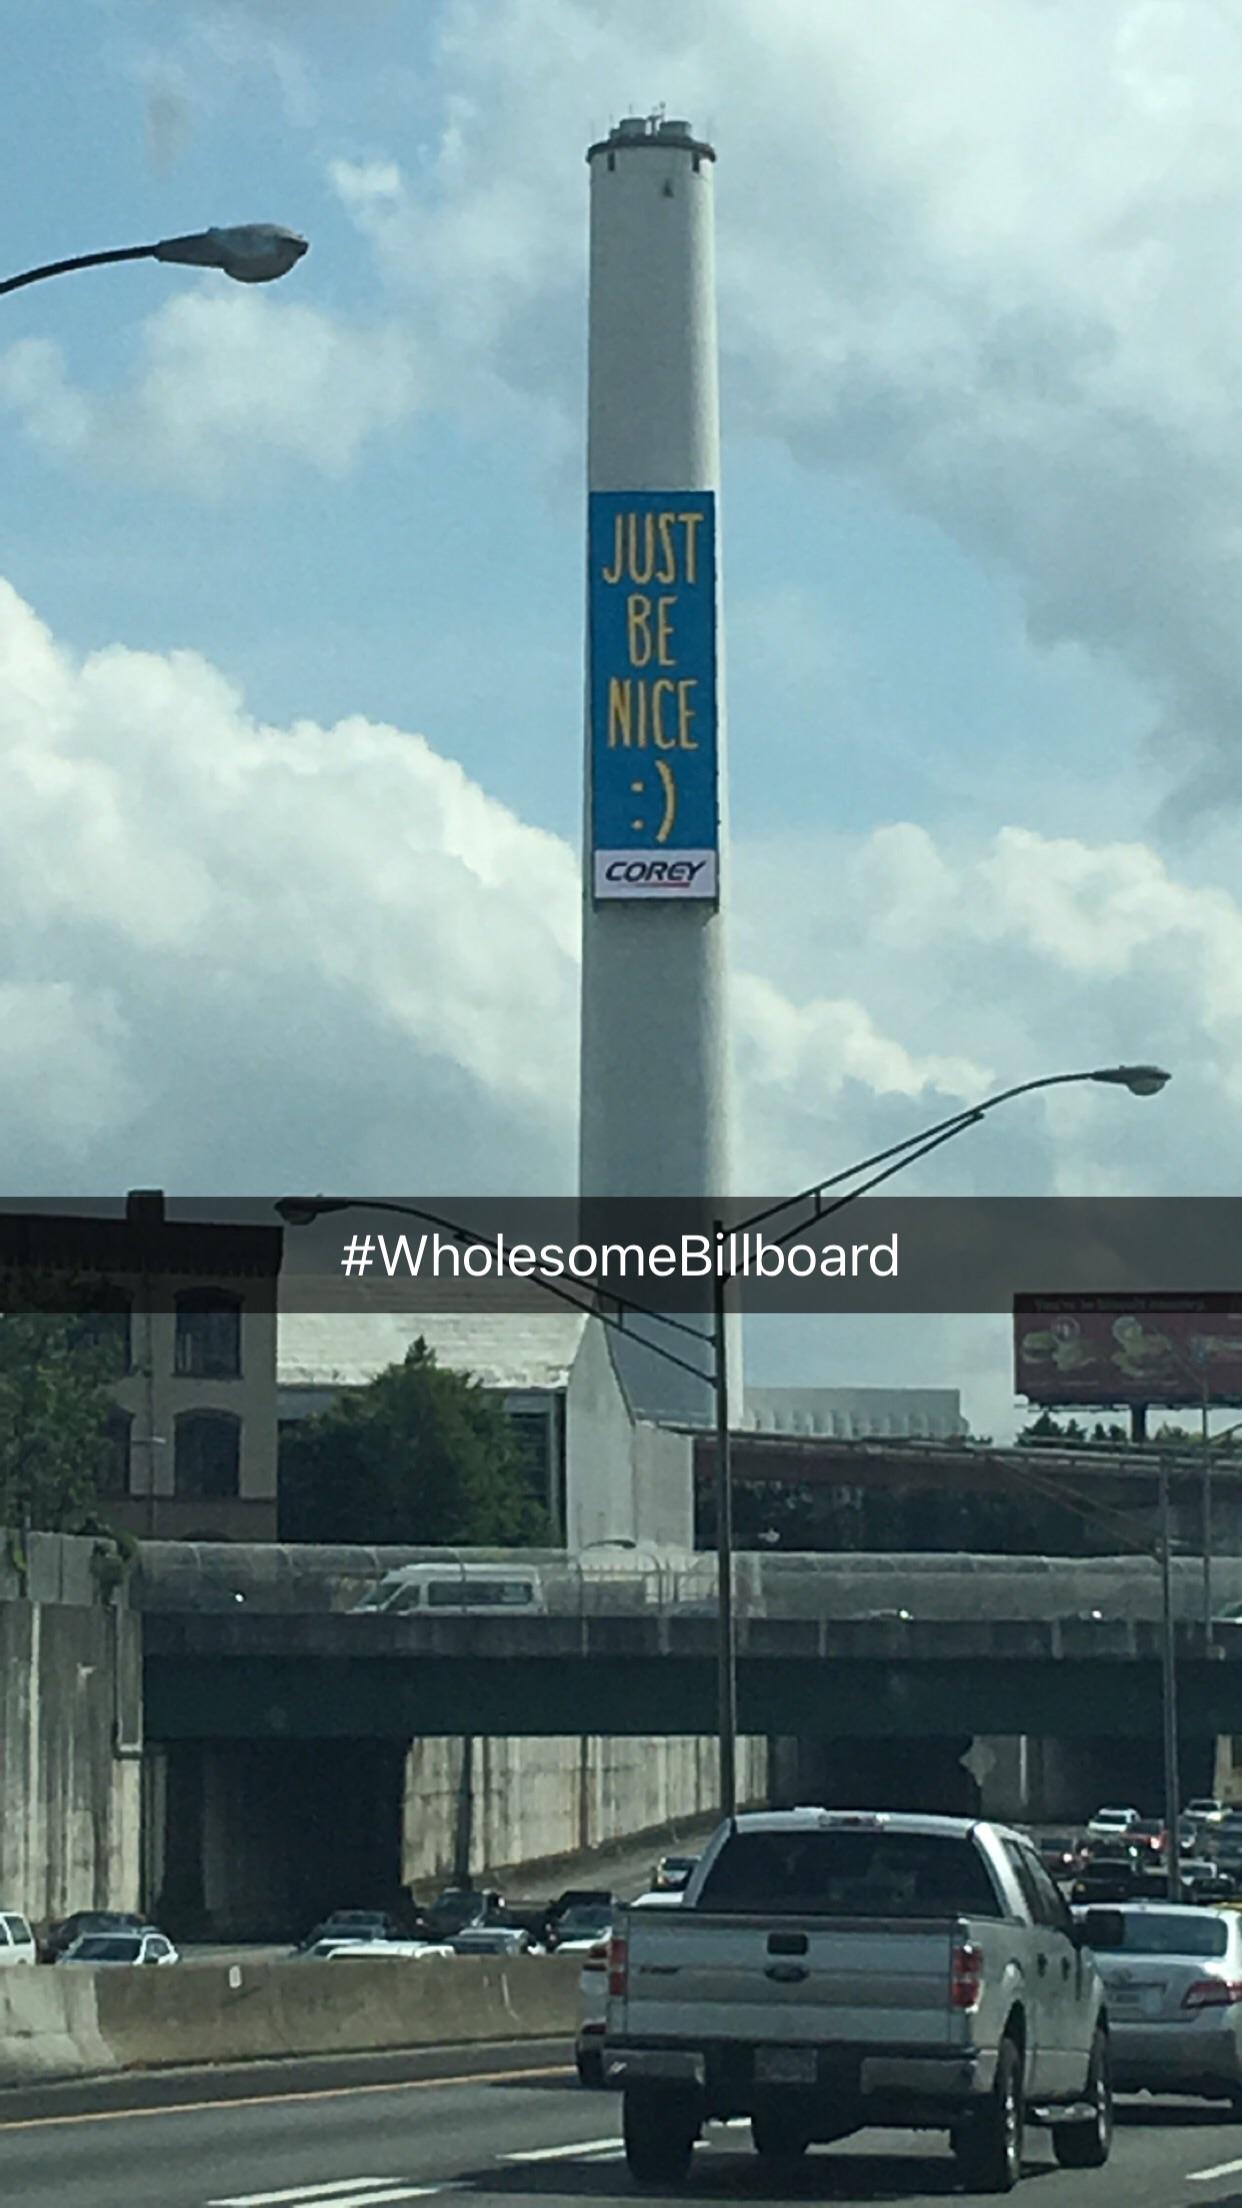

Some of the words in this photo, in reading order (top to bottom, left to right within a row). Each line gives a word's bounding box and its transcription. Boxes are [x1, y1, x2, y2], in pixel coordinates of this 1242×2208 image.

[602, 512, 704, 584] JUST
[627, 592, 678, 666] BE
[608, 676, 699, 749] NICE
[605, 860, 706, 882] COREY
